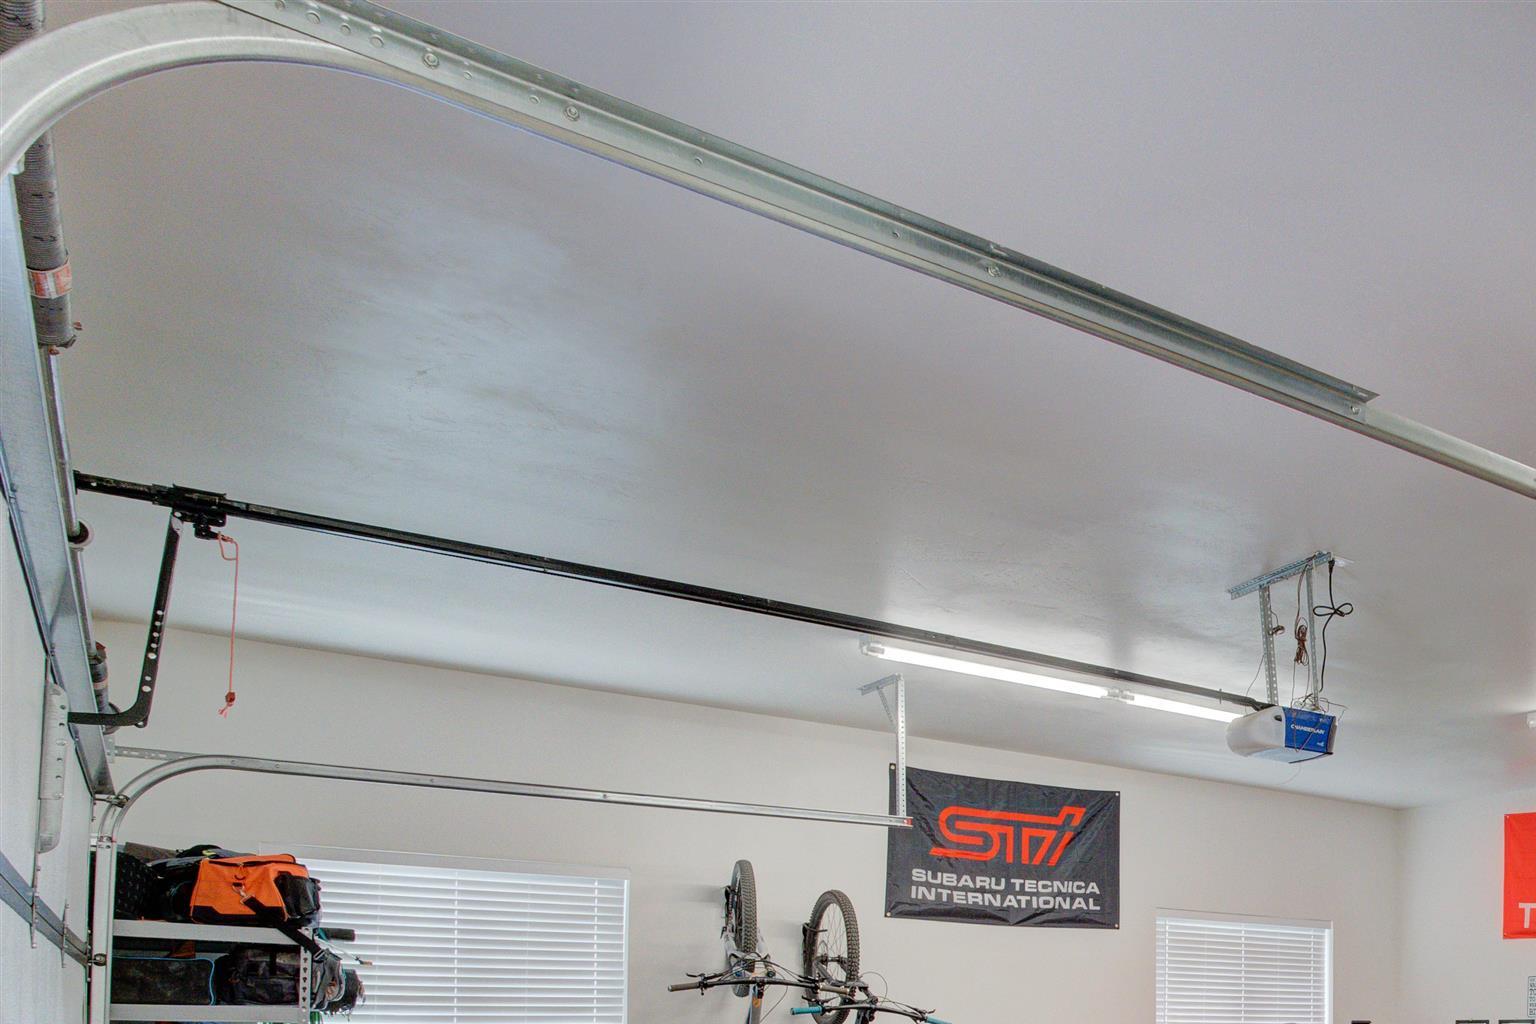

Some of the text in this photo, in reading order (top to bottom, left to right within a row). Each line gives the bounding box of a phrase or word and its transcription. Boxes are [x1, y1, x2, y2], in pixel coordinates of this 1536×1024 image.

[911, 868, 1100, 894] SUBARU TECNICA
[911, 886, 1101, 911] INTERNATIONAL
